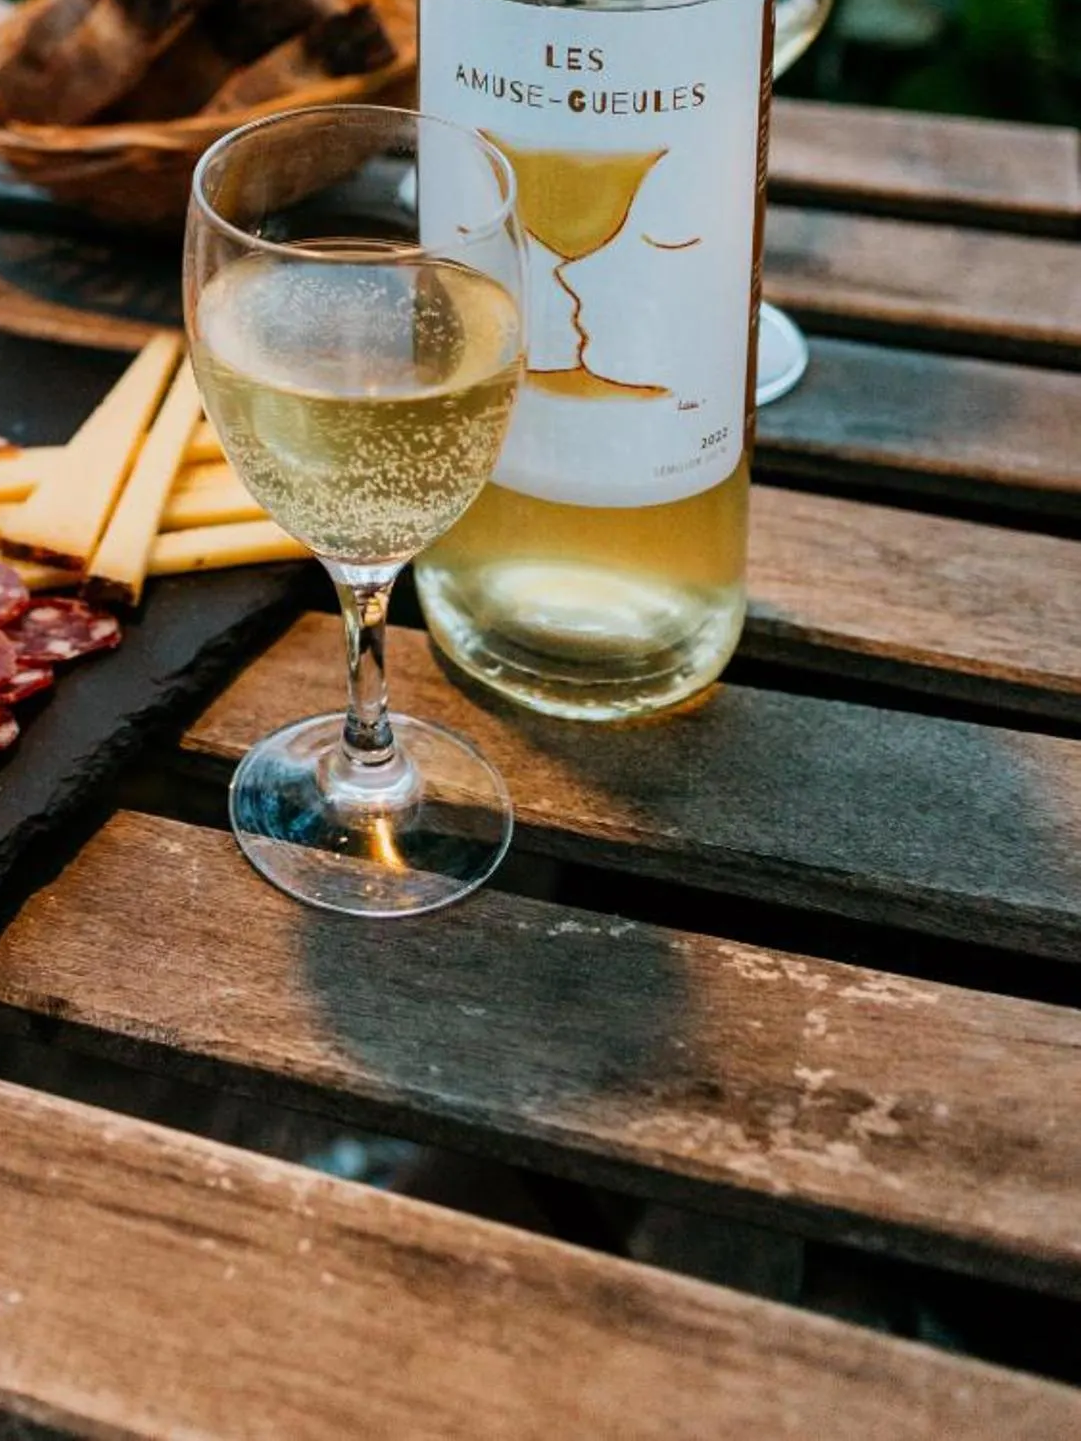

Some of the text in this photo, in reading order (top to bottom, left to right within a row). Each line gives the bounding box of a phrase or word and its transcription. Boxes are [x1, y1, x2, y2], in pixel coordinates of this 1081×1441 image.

[546, 44, 605, 72] LES
[455, 63, 706, 115] AMUSE-GUEULES
[701, 427, 728, 449] 2022
